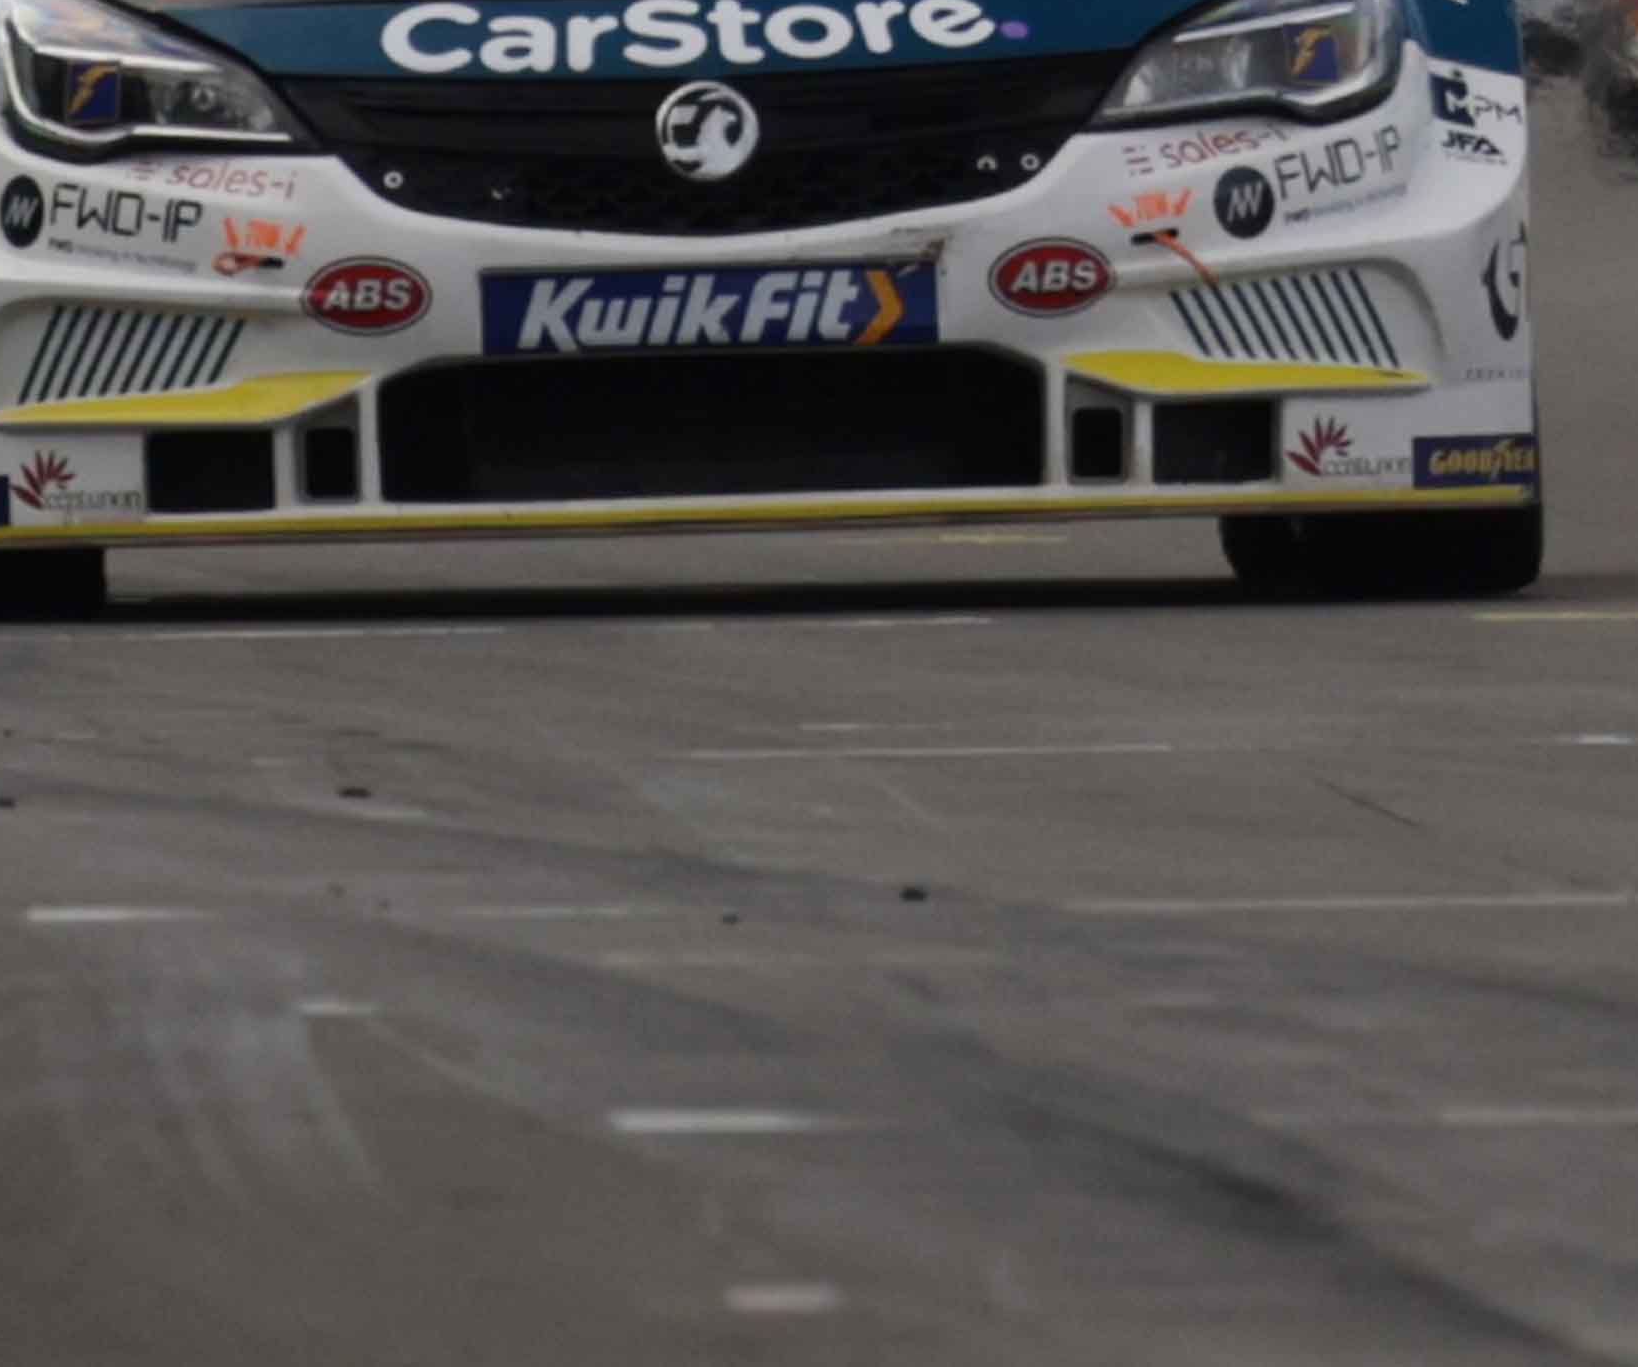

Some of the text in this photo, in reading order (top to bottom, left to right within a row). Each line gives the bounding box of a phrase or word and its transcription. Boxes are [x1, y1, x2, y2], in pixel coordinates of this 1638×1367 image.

[51, 183, 204, 242] FWD-IP
[323, 277, 413, 311] ABS
[1010, 260, 1098, 291] ABS
[518, 269, 860, 353] KwikFit
